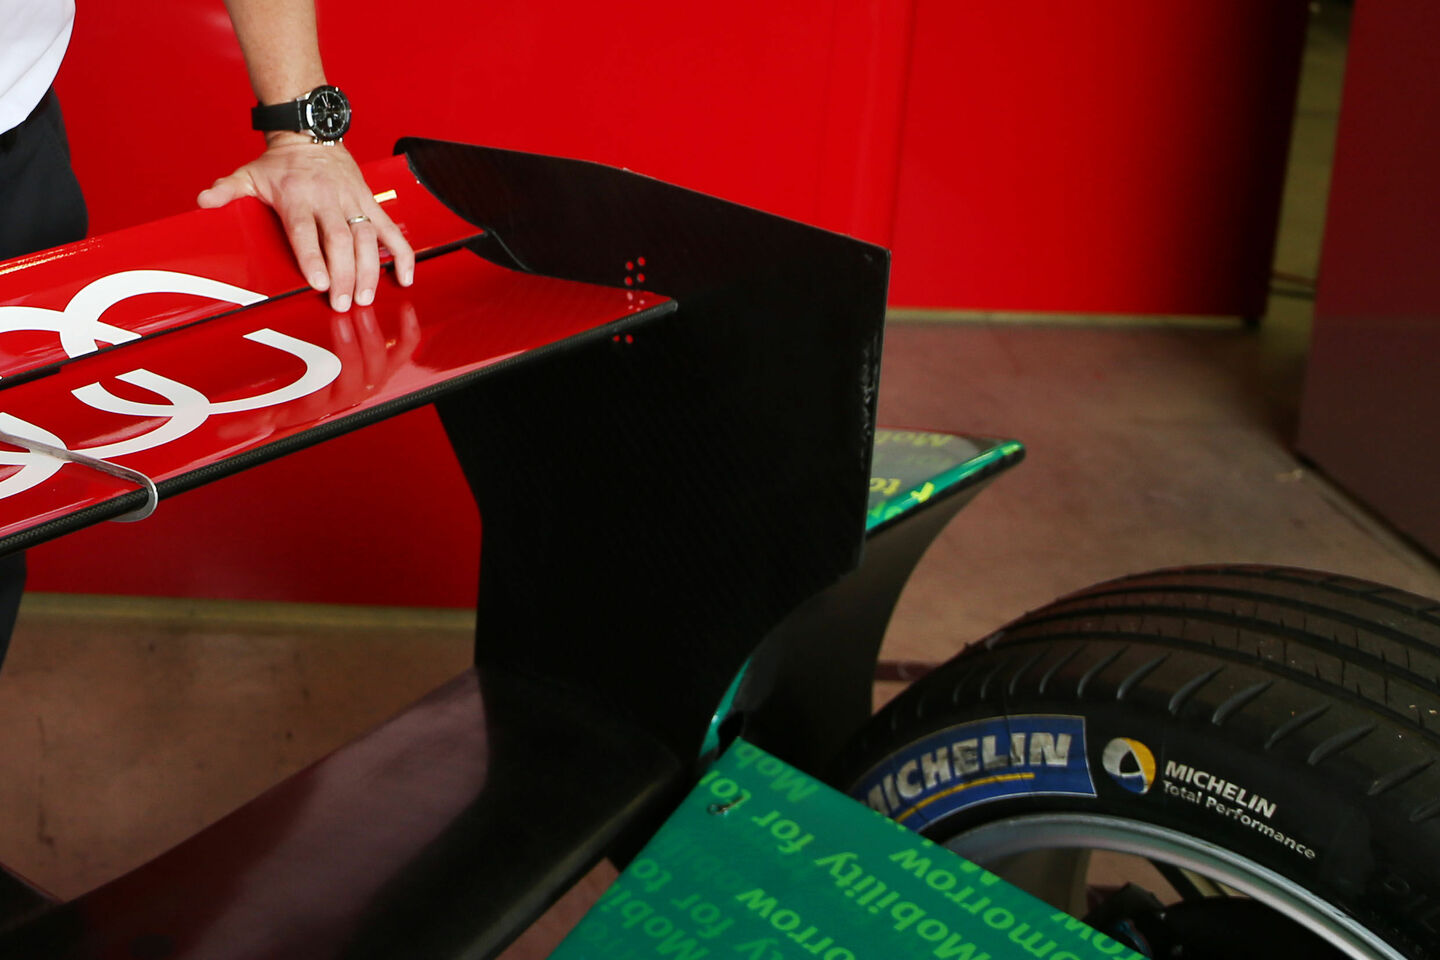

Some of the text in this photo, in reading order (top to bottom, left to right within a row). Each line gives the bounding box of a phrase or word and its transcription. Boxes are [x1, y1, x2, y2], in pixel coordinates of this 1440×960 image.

[1164, 759, 1278, 819] MICHELIN
[751, 810, 815, 854] for
[1162, 779, 1317, 860] Total Performance
